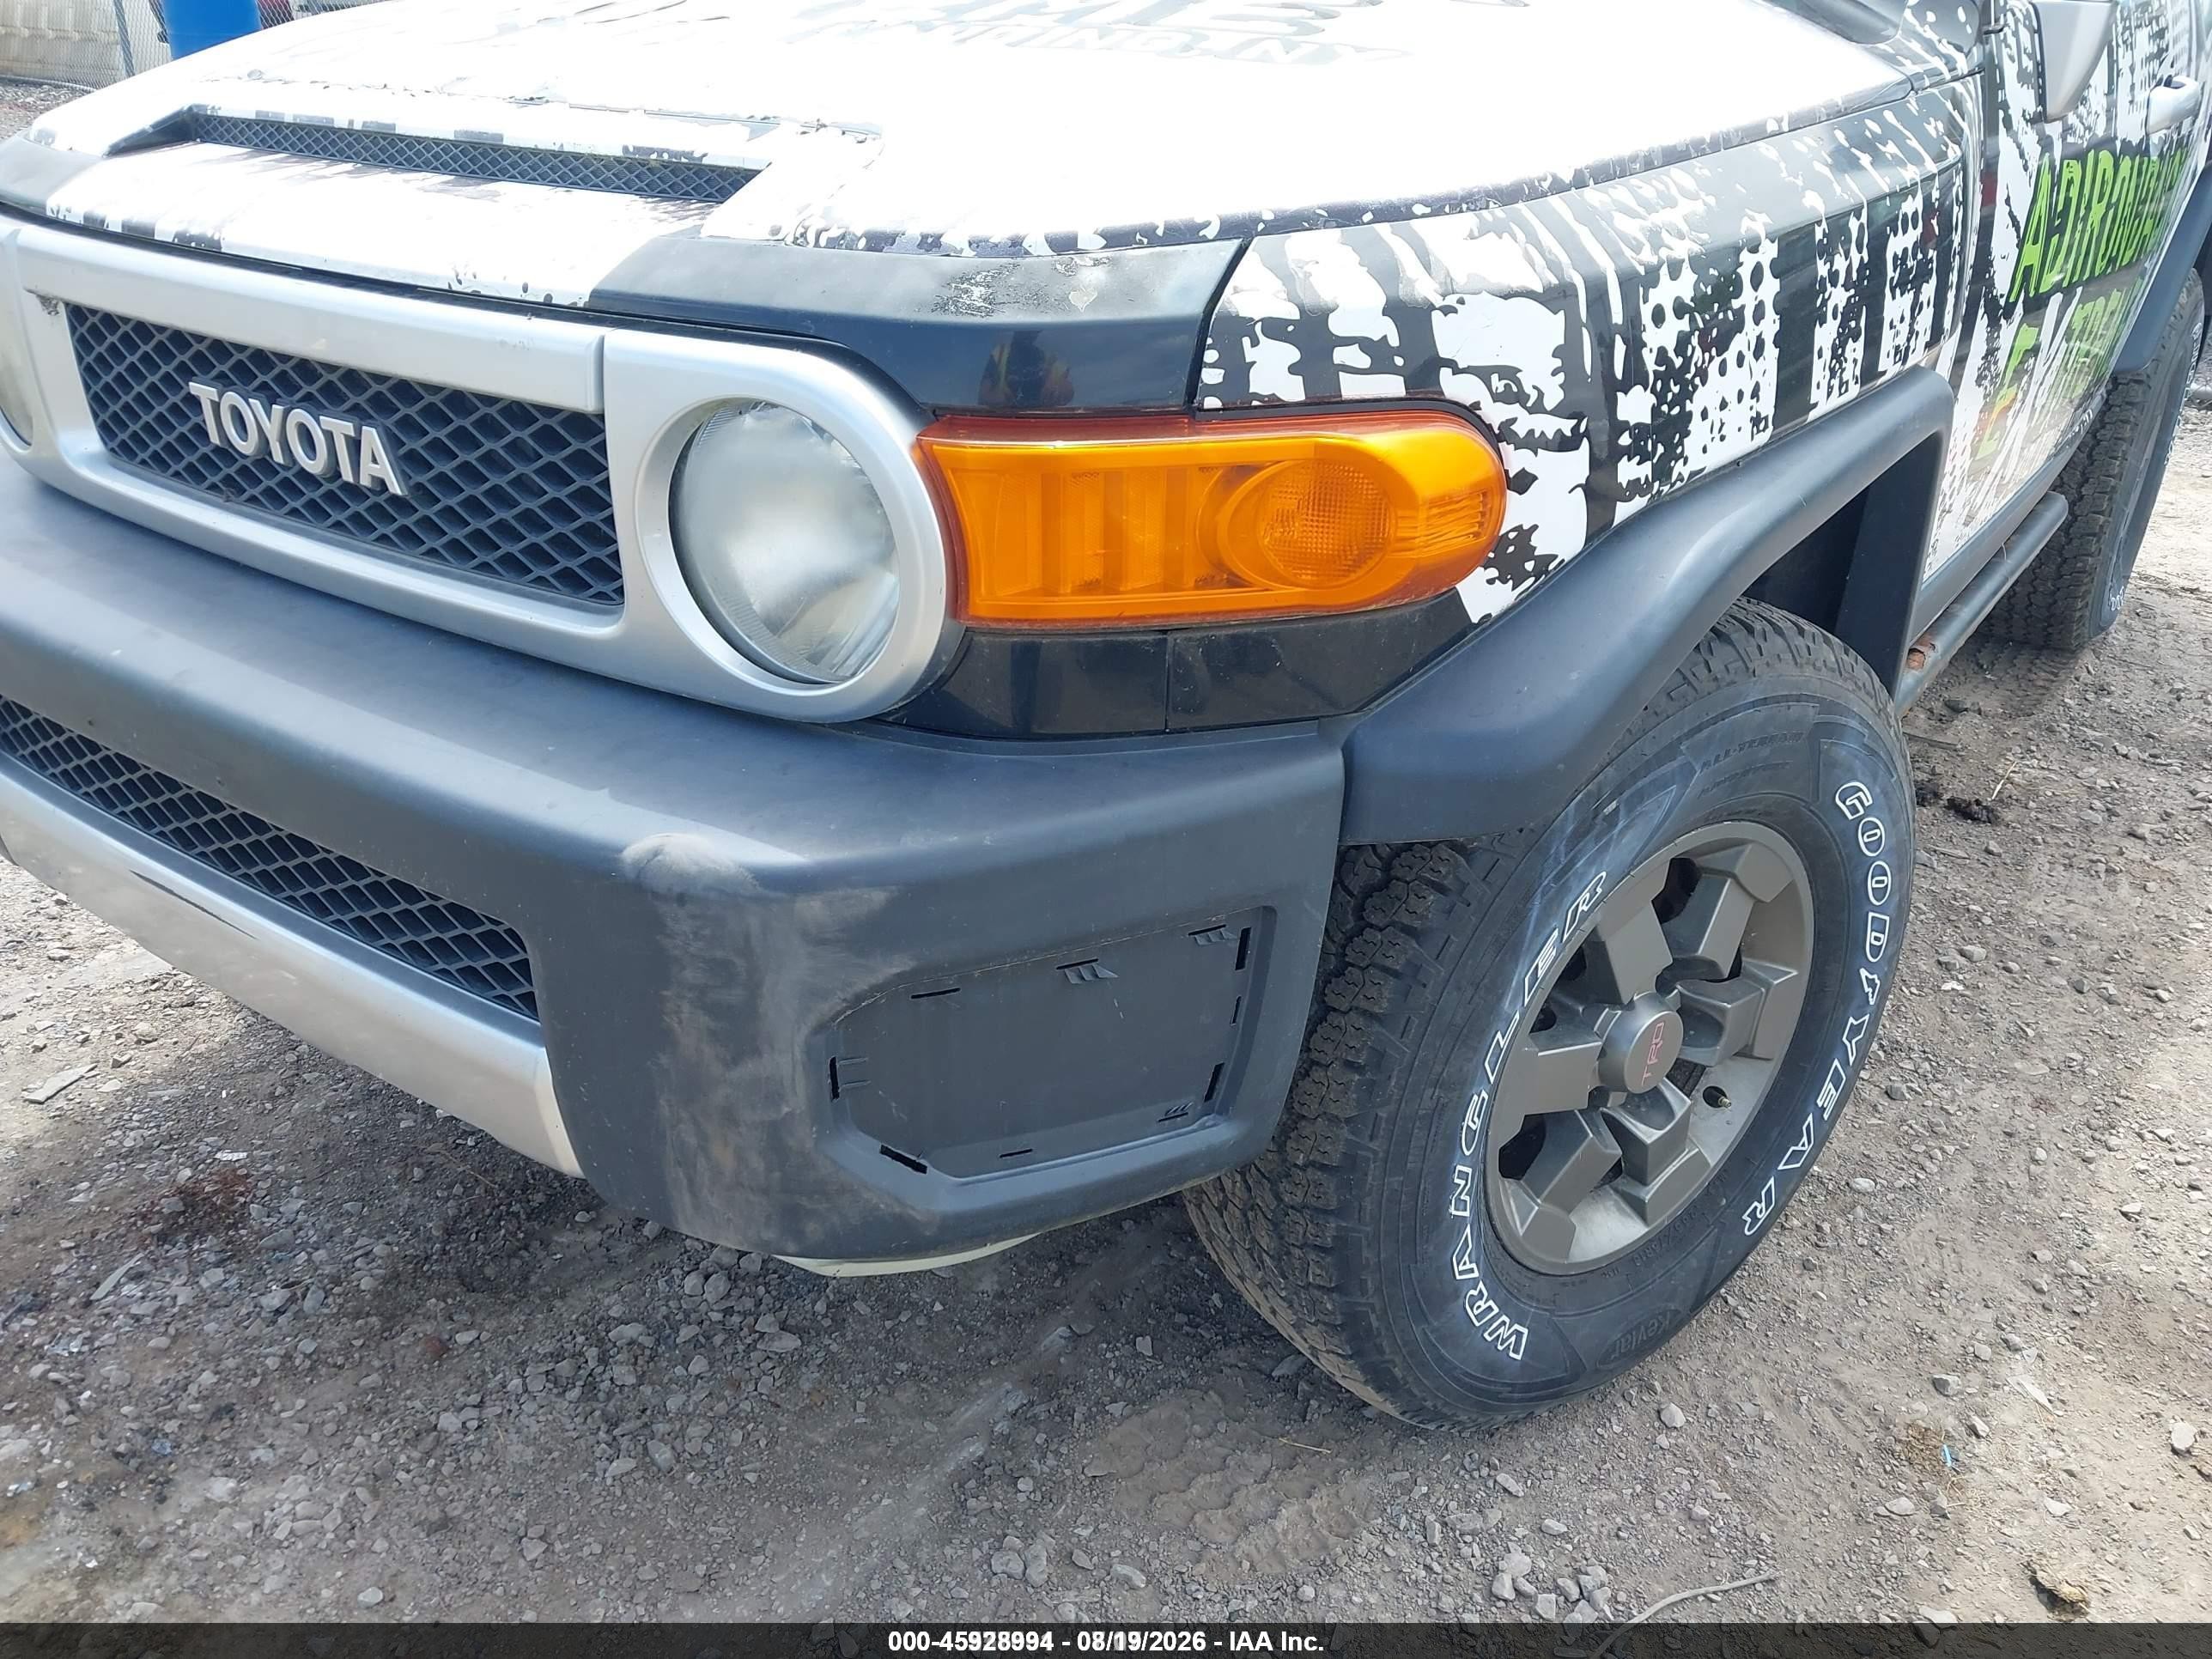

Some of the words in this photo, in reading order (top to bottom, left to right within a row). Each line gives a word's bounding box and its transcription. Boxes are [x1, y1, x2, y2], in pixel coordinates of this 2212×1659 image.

[188, 381, 404, 496] TOYOTA
[1449, 870, 1607, 1361] WRANGLER
[1641, 1021, 1665, 1086] TRD
[1741, 781, 1893, 1237] GOODYEAR
